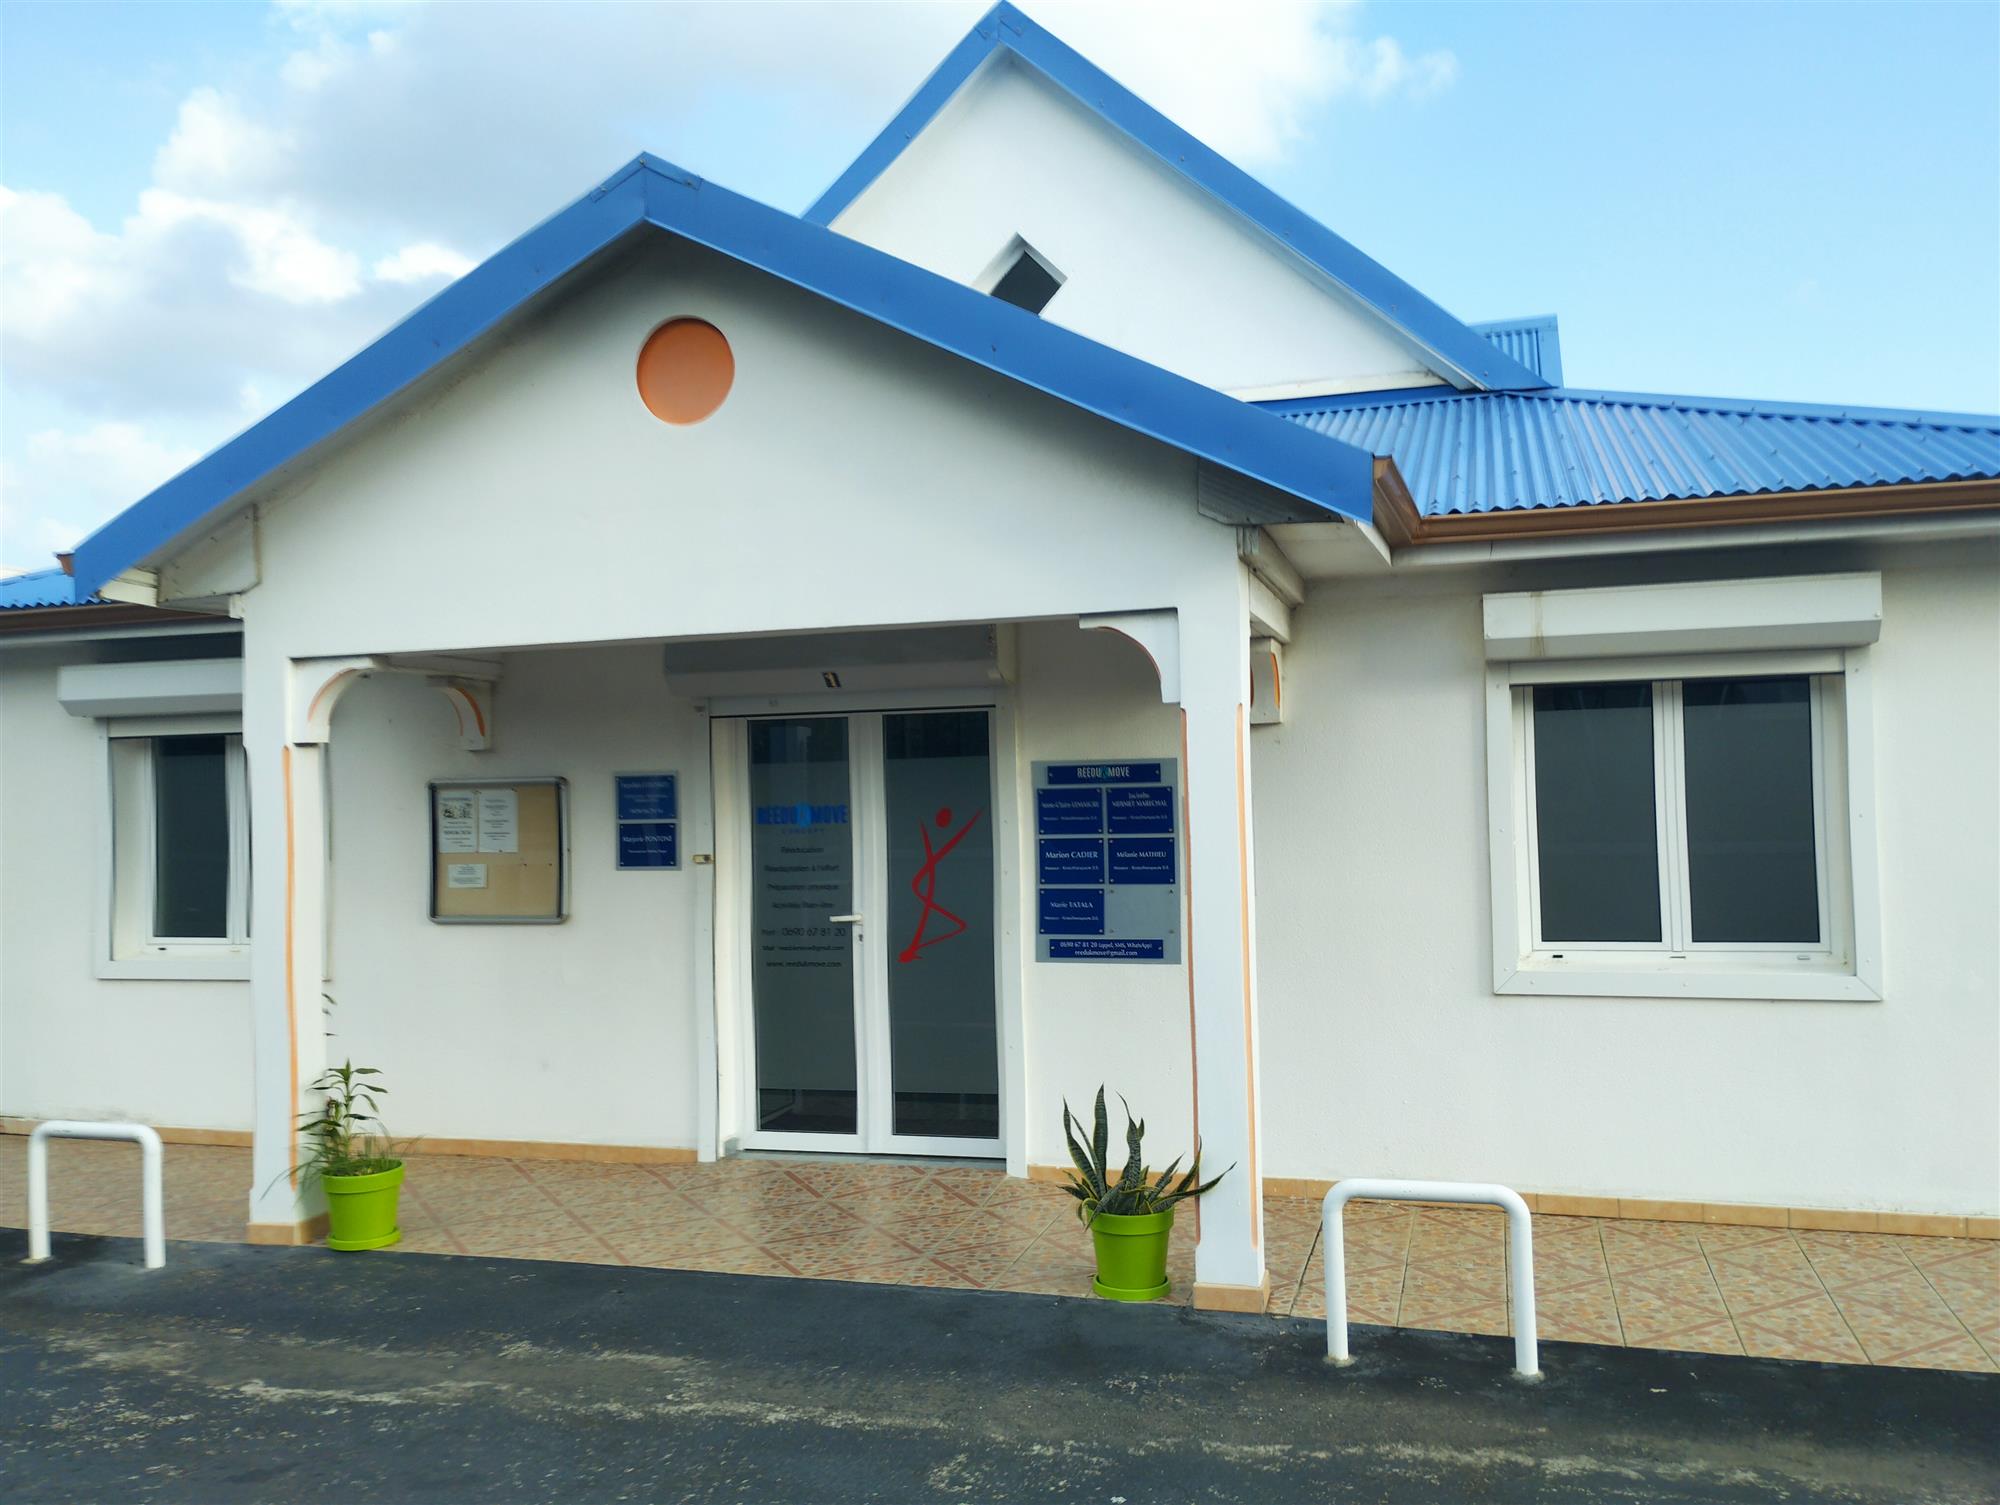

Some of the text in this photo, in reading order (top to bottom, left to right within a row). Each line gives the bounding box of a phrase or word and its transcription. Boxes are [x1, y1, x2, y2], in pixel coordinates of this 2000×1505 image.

[1045, 851, 1099, 859] Marion CADIER
[782, 927, 805, 937] 0690
[834, 927, 846, 937] 20
